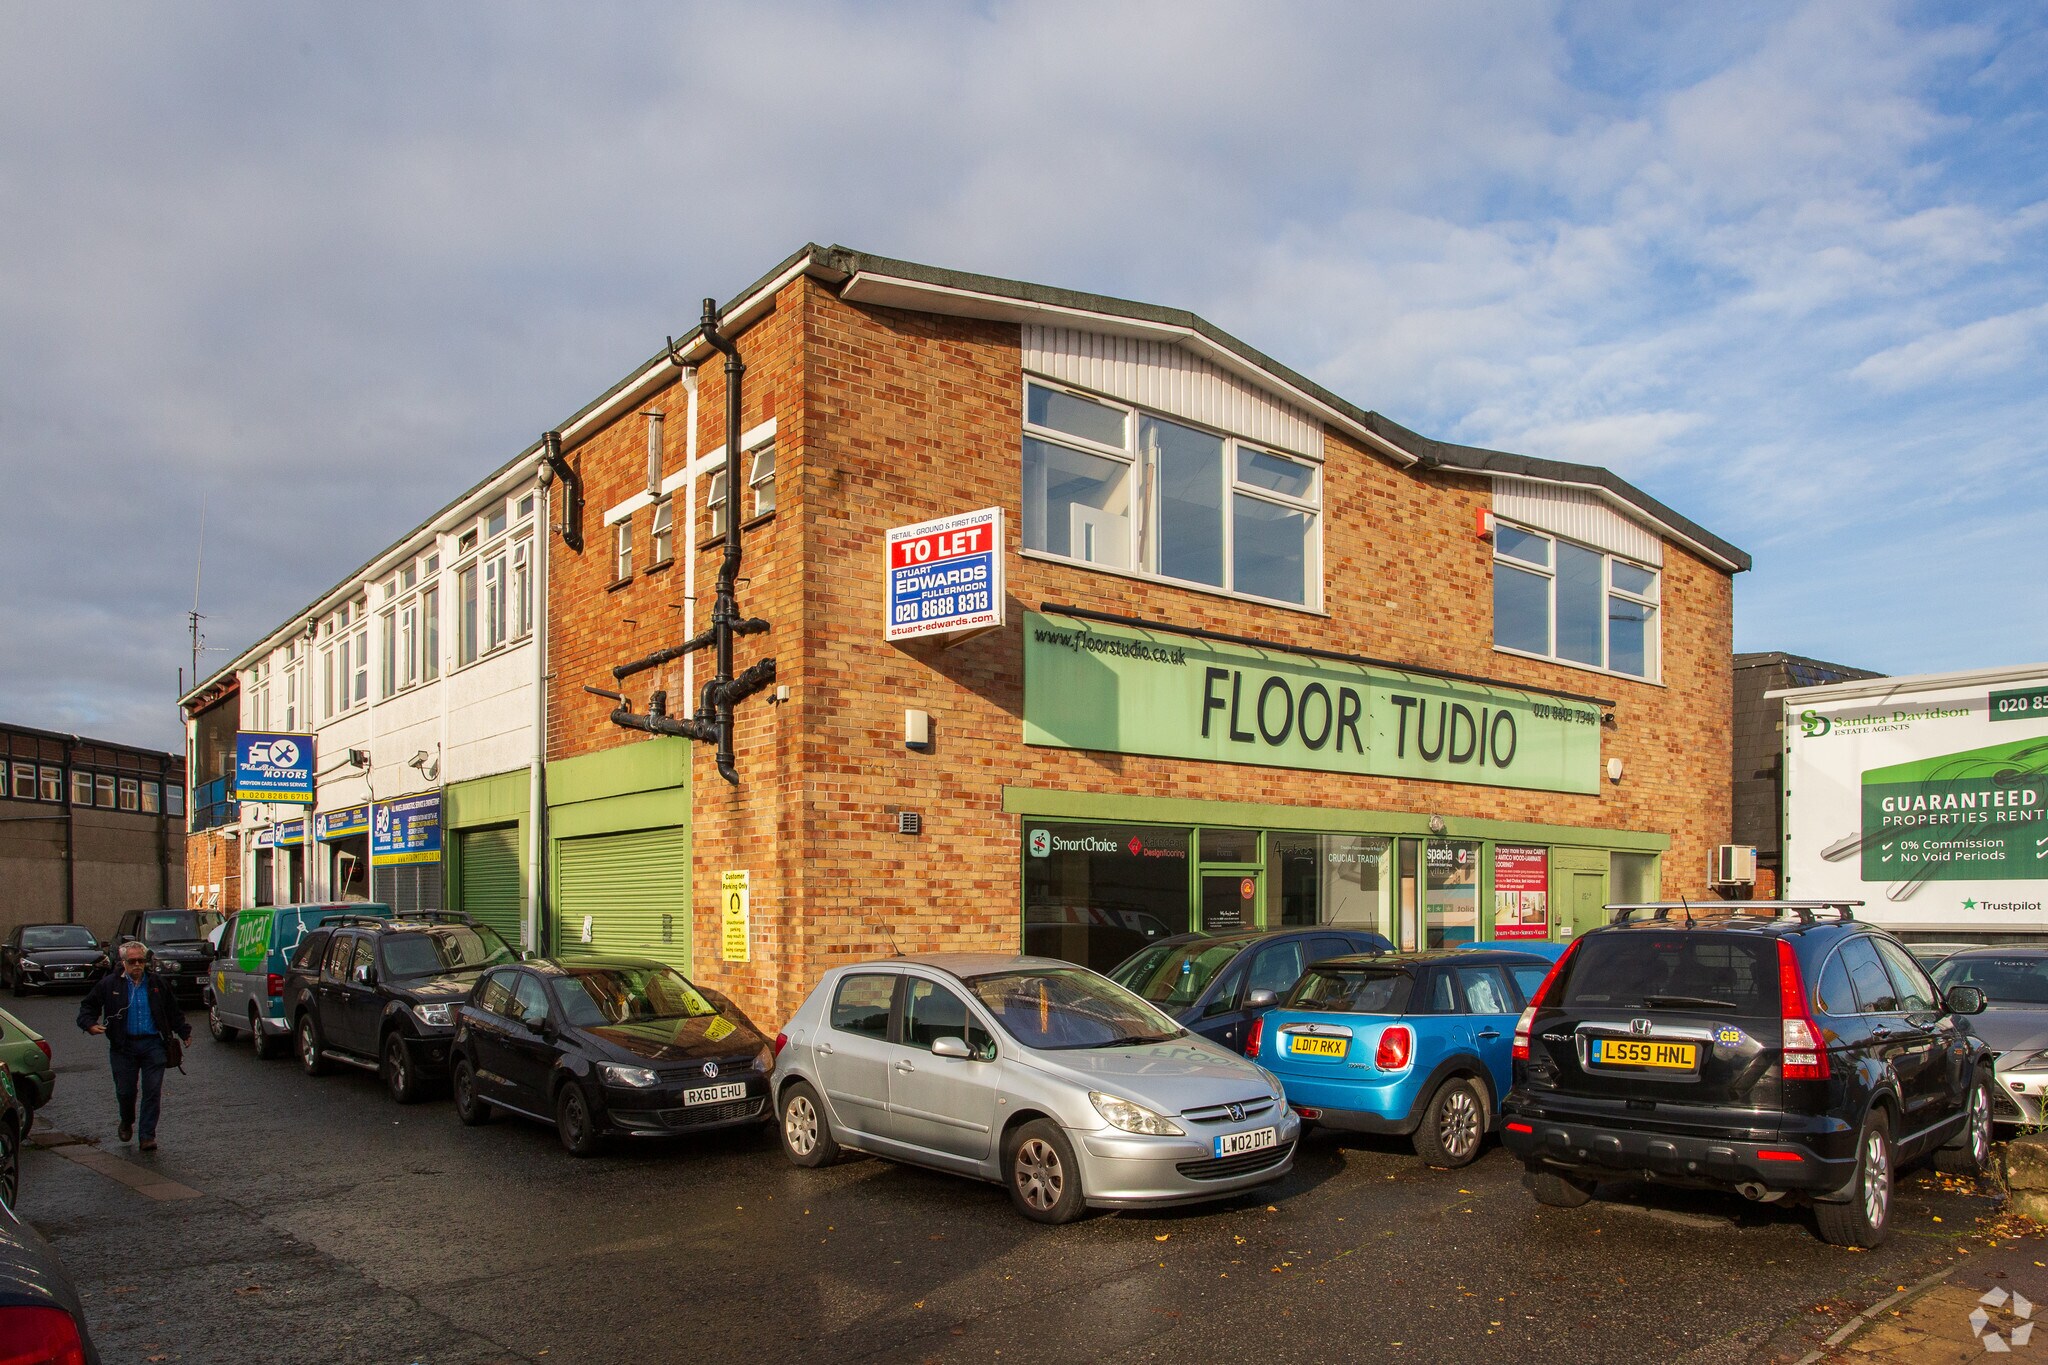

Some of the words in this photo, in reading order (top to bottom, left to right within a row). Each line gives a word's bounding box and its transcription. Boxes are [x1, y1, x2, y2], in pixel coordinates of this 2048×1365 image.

[892, 531, 912, 540] RETAIL
[916, 524, 944, 536] GROUND
[945, 522, 950, 530] &
[952, 518, 970, 528] FIRST
[971, 513, 993, 524] FLOOR
[901, 539, 930, 564] TO
[938, 528, 982, 558] LET
[896, 566, 932, 579] STUART
[896, 565, 987, 594] EDWARDS
[921, 582, 987, 599] FULLERMOON
[896, 603, 918, 623] 020
[922, 597, 954, 618] 8688
[958, 591, 988, 611] 8313
[891, 614, 994, 636] stuart-edwards.com
[1034, 629, 1187, 666] www.floorstudio.co.uk
[1533, 703, 1550, 718] 020
[1999, 697, 2027, 713] 020
[1201, 666, 1365, 755] FLOOR
[1390, 694, 1517, 768] TUDIO
[1834, 716, 1886, 729] Sandra
[1892, 707, 1970, 723] Davidson
[1834, 727, 1869, 736] ESTATE
[1872, 723, 1910, 733] AGENTS
[263, 770, 308, 779] MOTORS
[1881, 789, 2037, 812] GUARANTEED
[1883, 811, 1988, 826] PROPERTIES
[1996, 809, 2048, 822] RENT
[1052, 836, 1118, 852] SmartChoice
[1901, 841, 1919, 850] 0%
[1923, 839, 2004, 849] Commission
[1143, 848, 1185, 859] Designflooring
[1328, 854, 1355, 863] CRUCIAL
[1427, 844, 1453, 863] spacia
[1901, 853, 1918, 862] No
[1922, 852, 1951, 861] Void
[1955, 851, 2005, 861] Periods
[723, 883, 738, 891] Parking
[1980, 901, 2042, 912] Trustpilot
[238, 914, 269, 957] zipcar
[1720, 1031, 1740, 1043] GB
[1296, 1038, 1318, 1052] LD17
[1320, 1040, 1342, 1054] RKX
[1605, 1043, 1651, 1062] LS59
[1656, 1046, 1692, 1065] HNL
[688, 1089, 718, 1103] RX60
[721, 1085, 741, 1098] EHU
[1223, 1135, 1252, 1154] LW02
[1254, 1130, 1273, 1147] DTF
